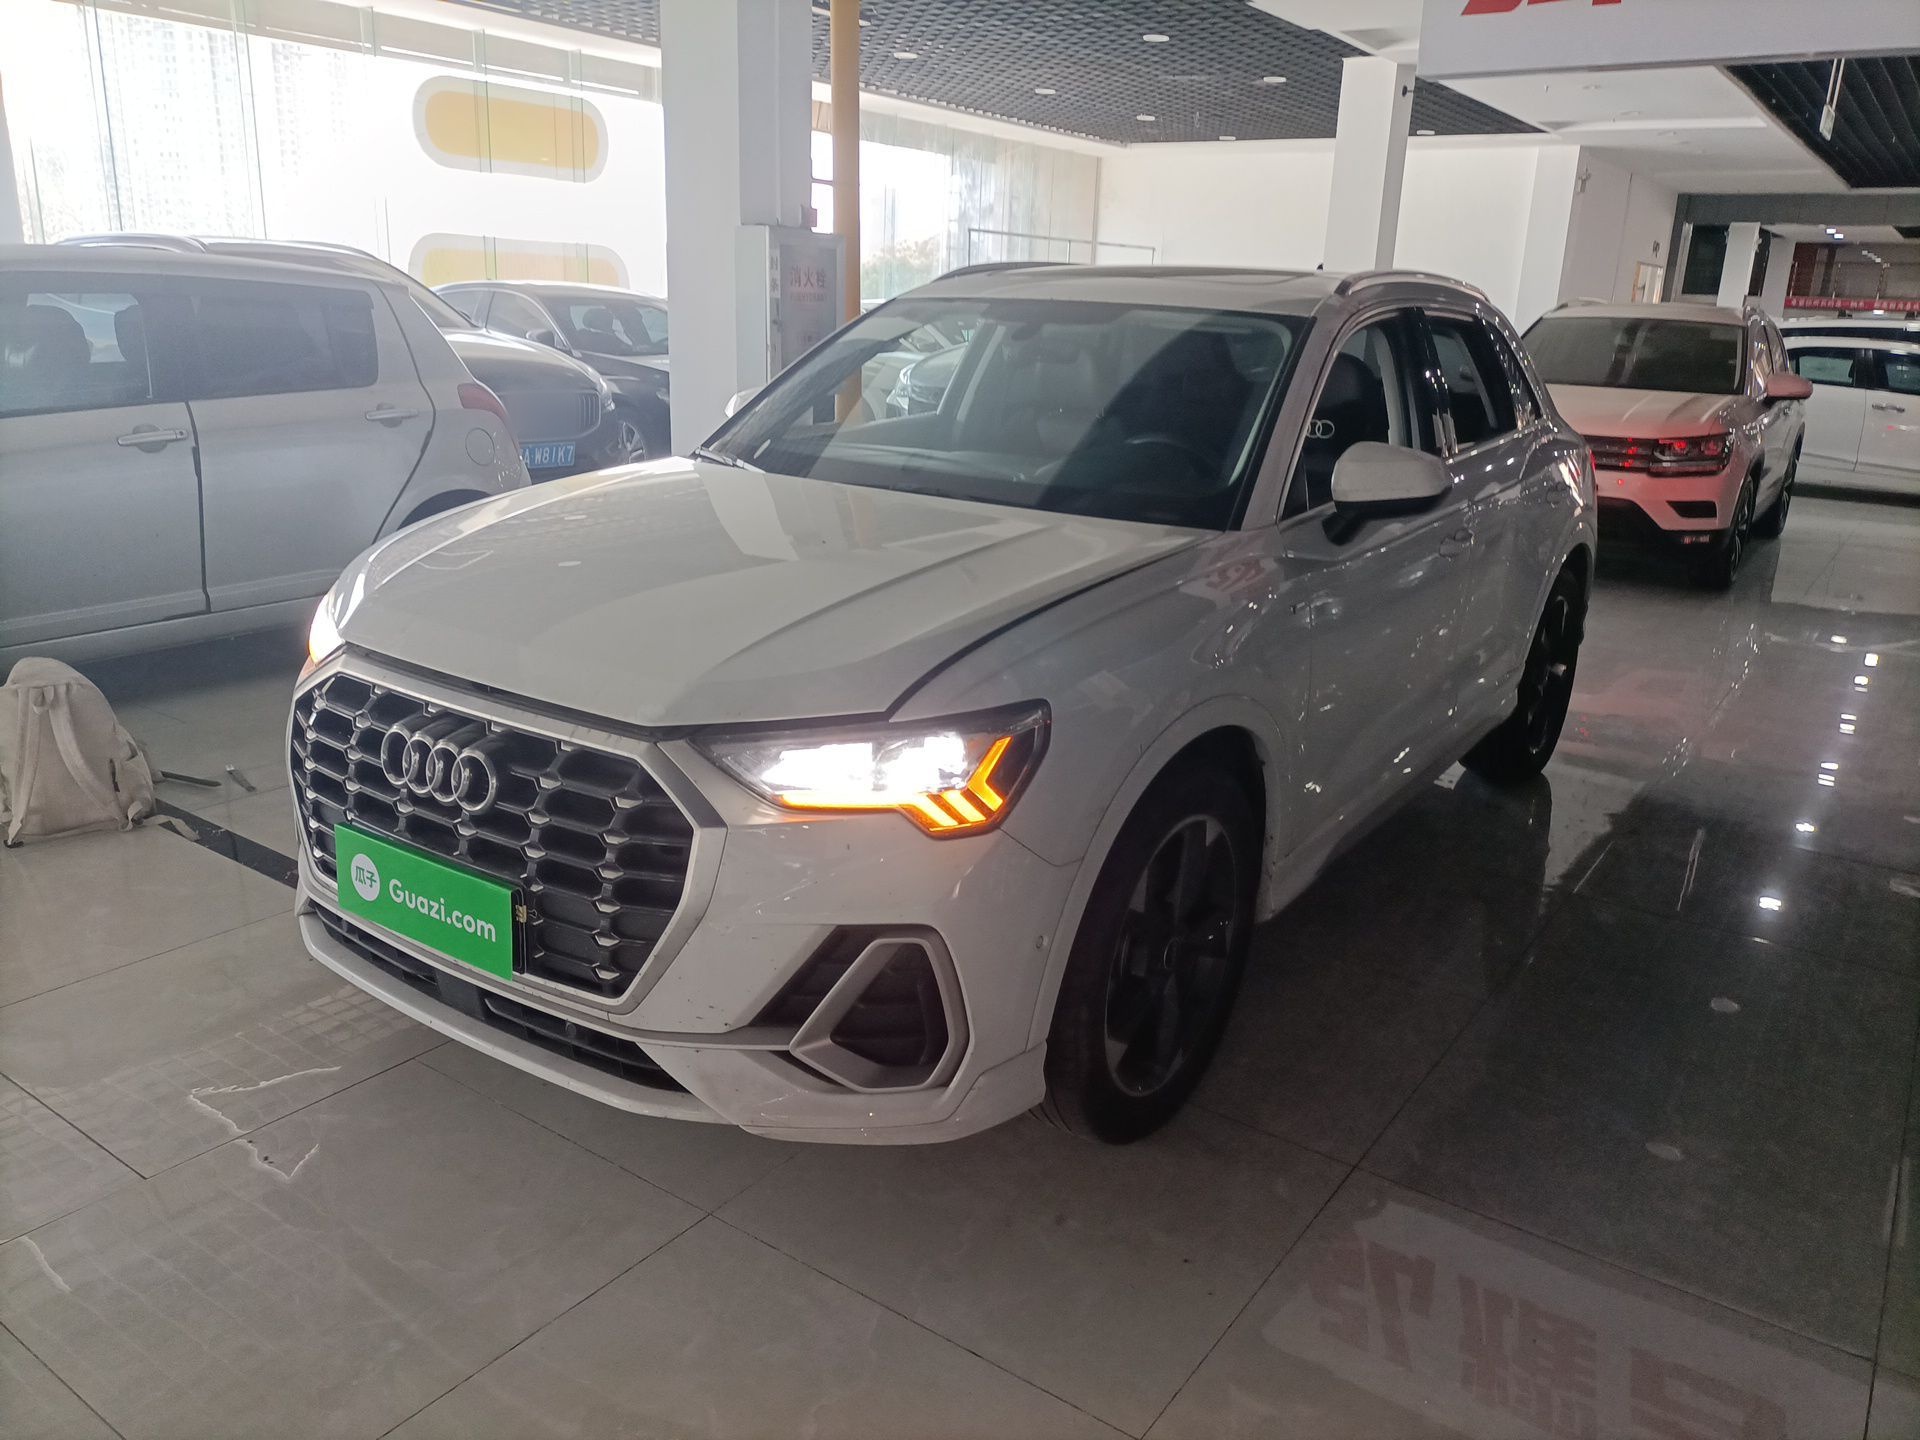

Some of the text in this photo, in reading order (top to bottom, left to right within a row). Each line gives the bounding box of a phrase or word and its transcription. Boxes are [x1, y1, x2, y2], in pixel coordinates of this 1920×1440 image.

[789, 266, 827, 289] 消火栓
[354, 865, 377, 888] 瓜子
[388, 879, 497, 943] Guazi.com
